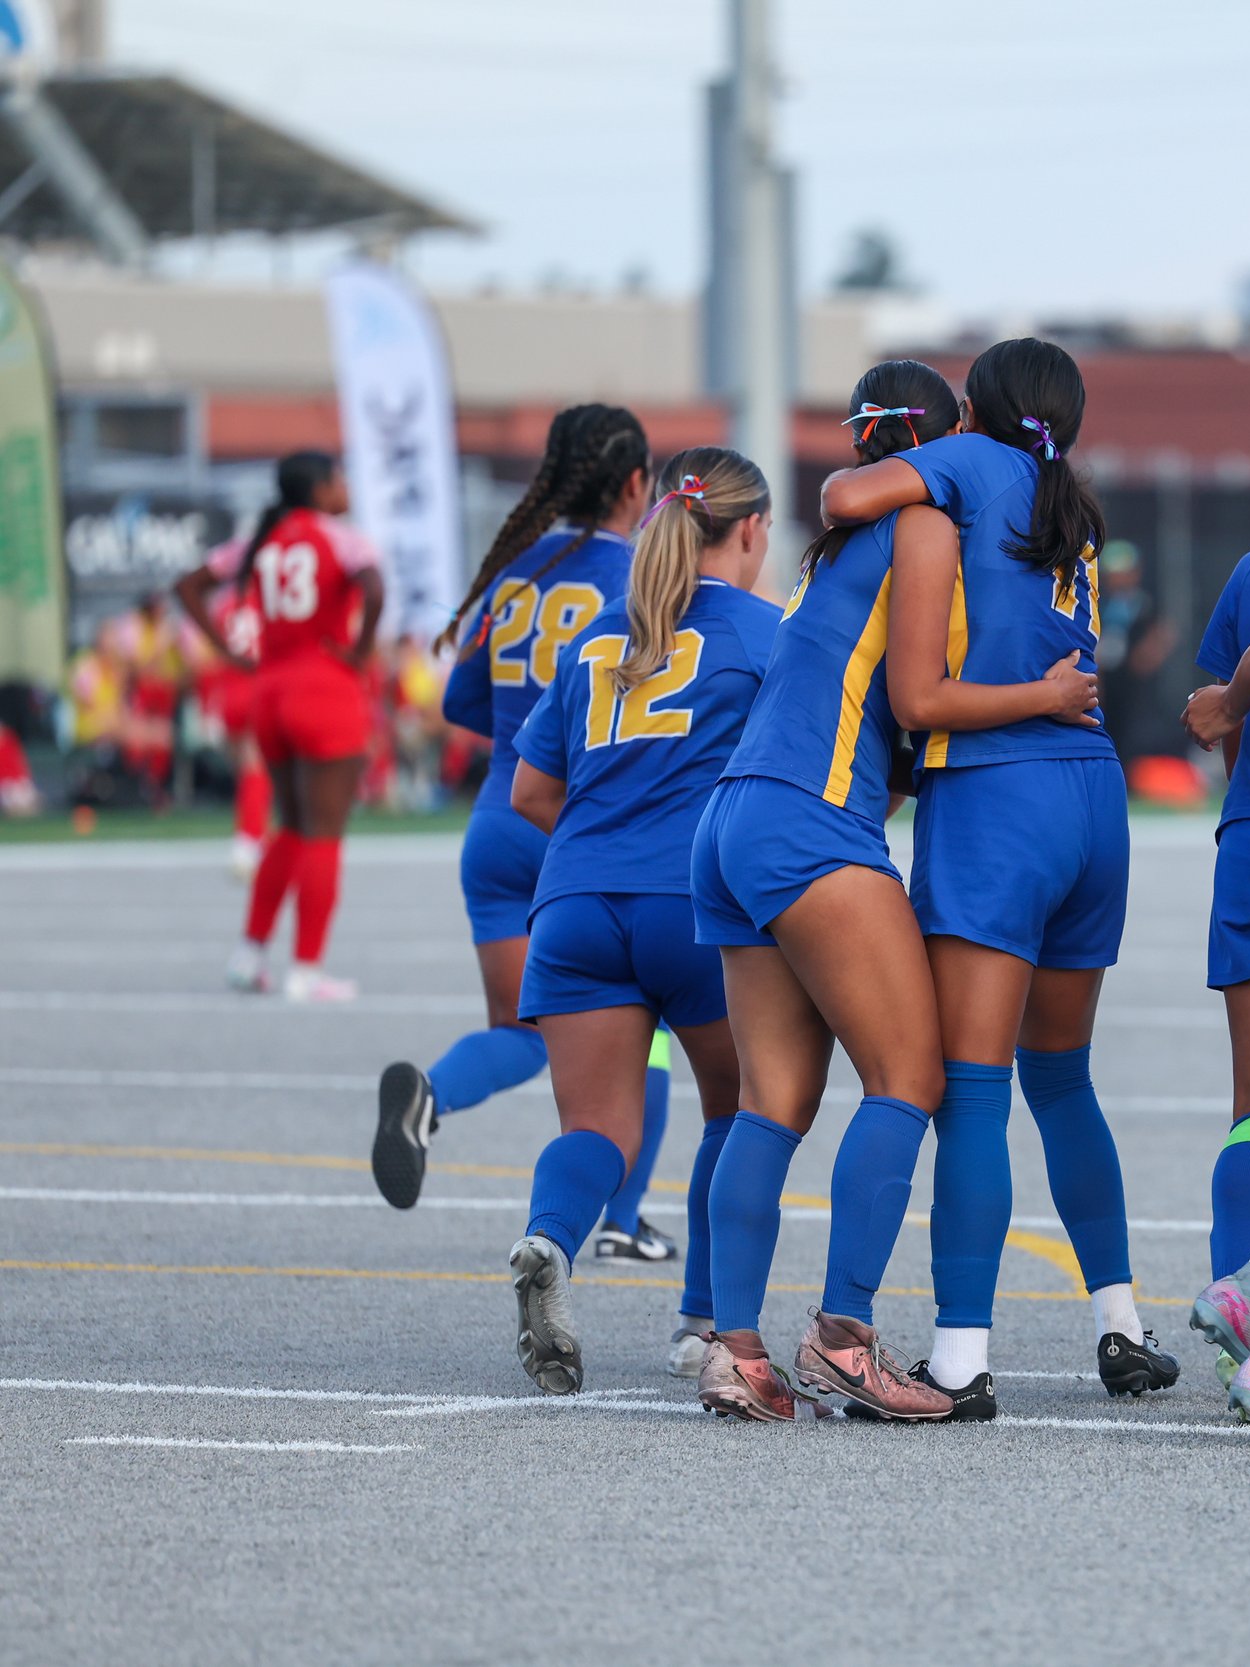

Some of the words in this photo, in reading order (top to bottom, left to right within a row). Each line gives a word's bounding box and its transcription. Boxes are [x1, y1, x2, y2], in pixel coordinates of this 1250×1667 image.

[254, 541, 319, 622] 13
[489, 577, 605, 689] 28
[578, 627, 705, 752] 12
